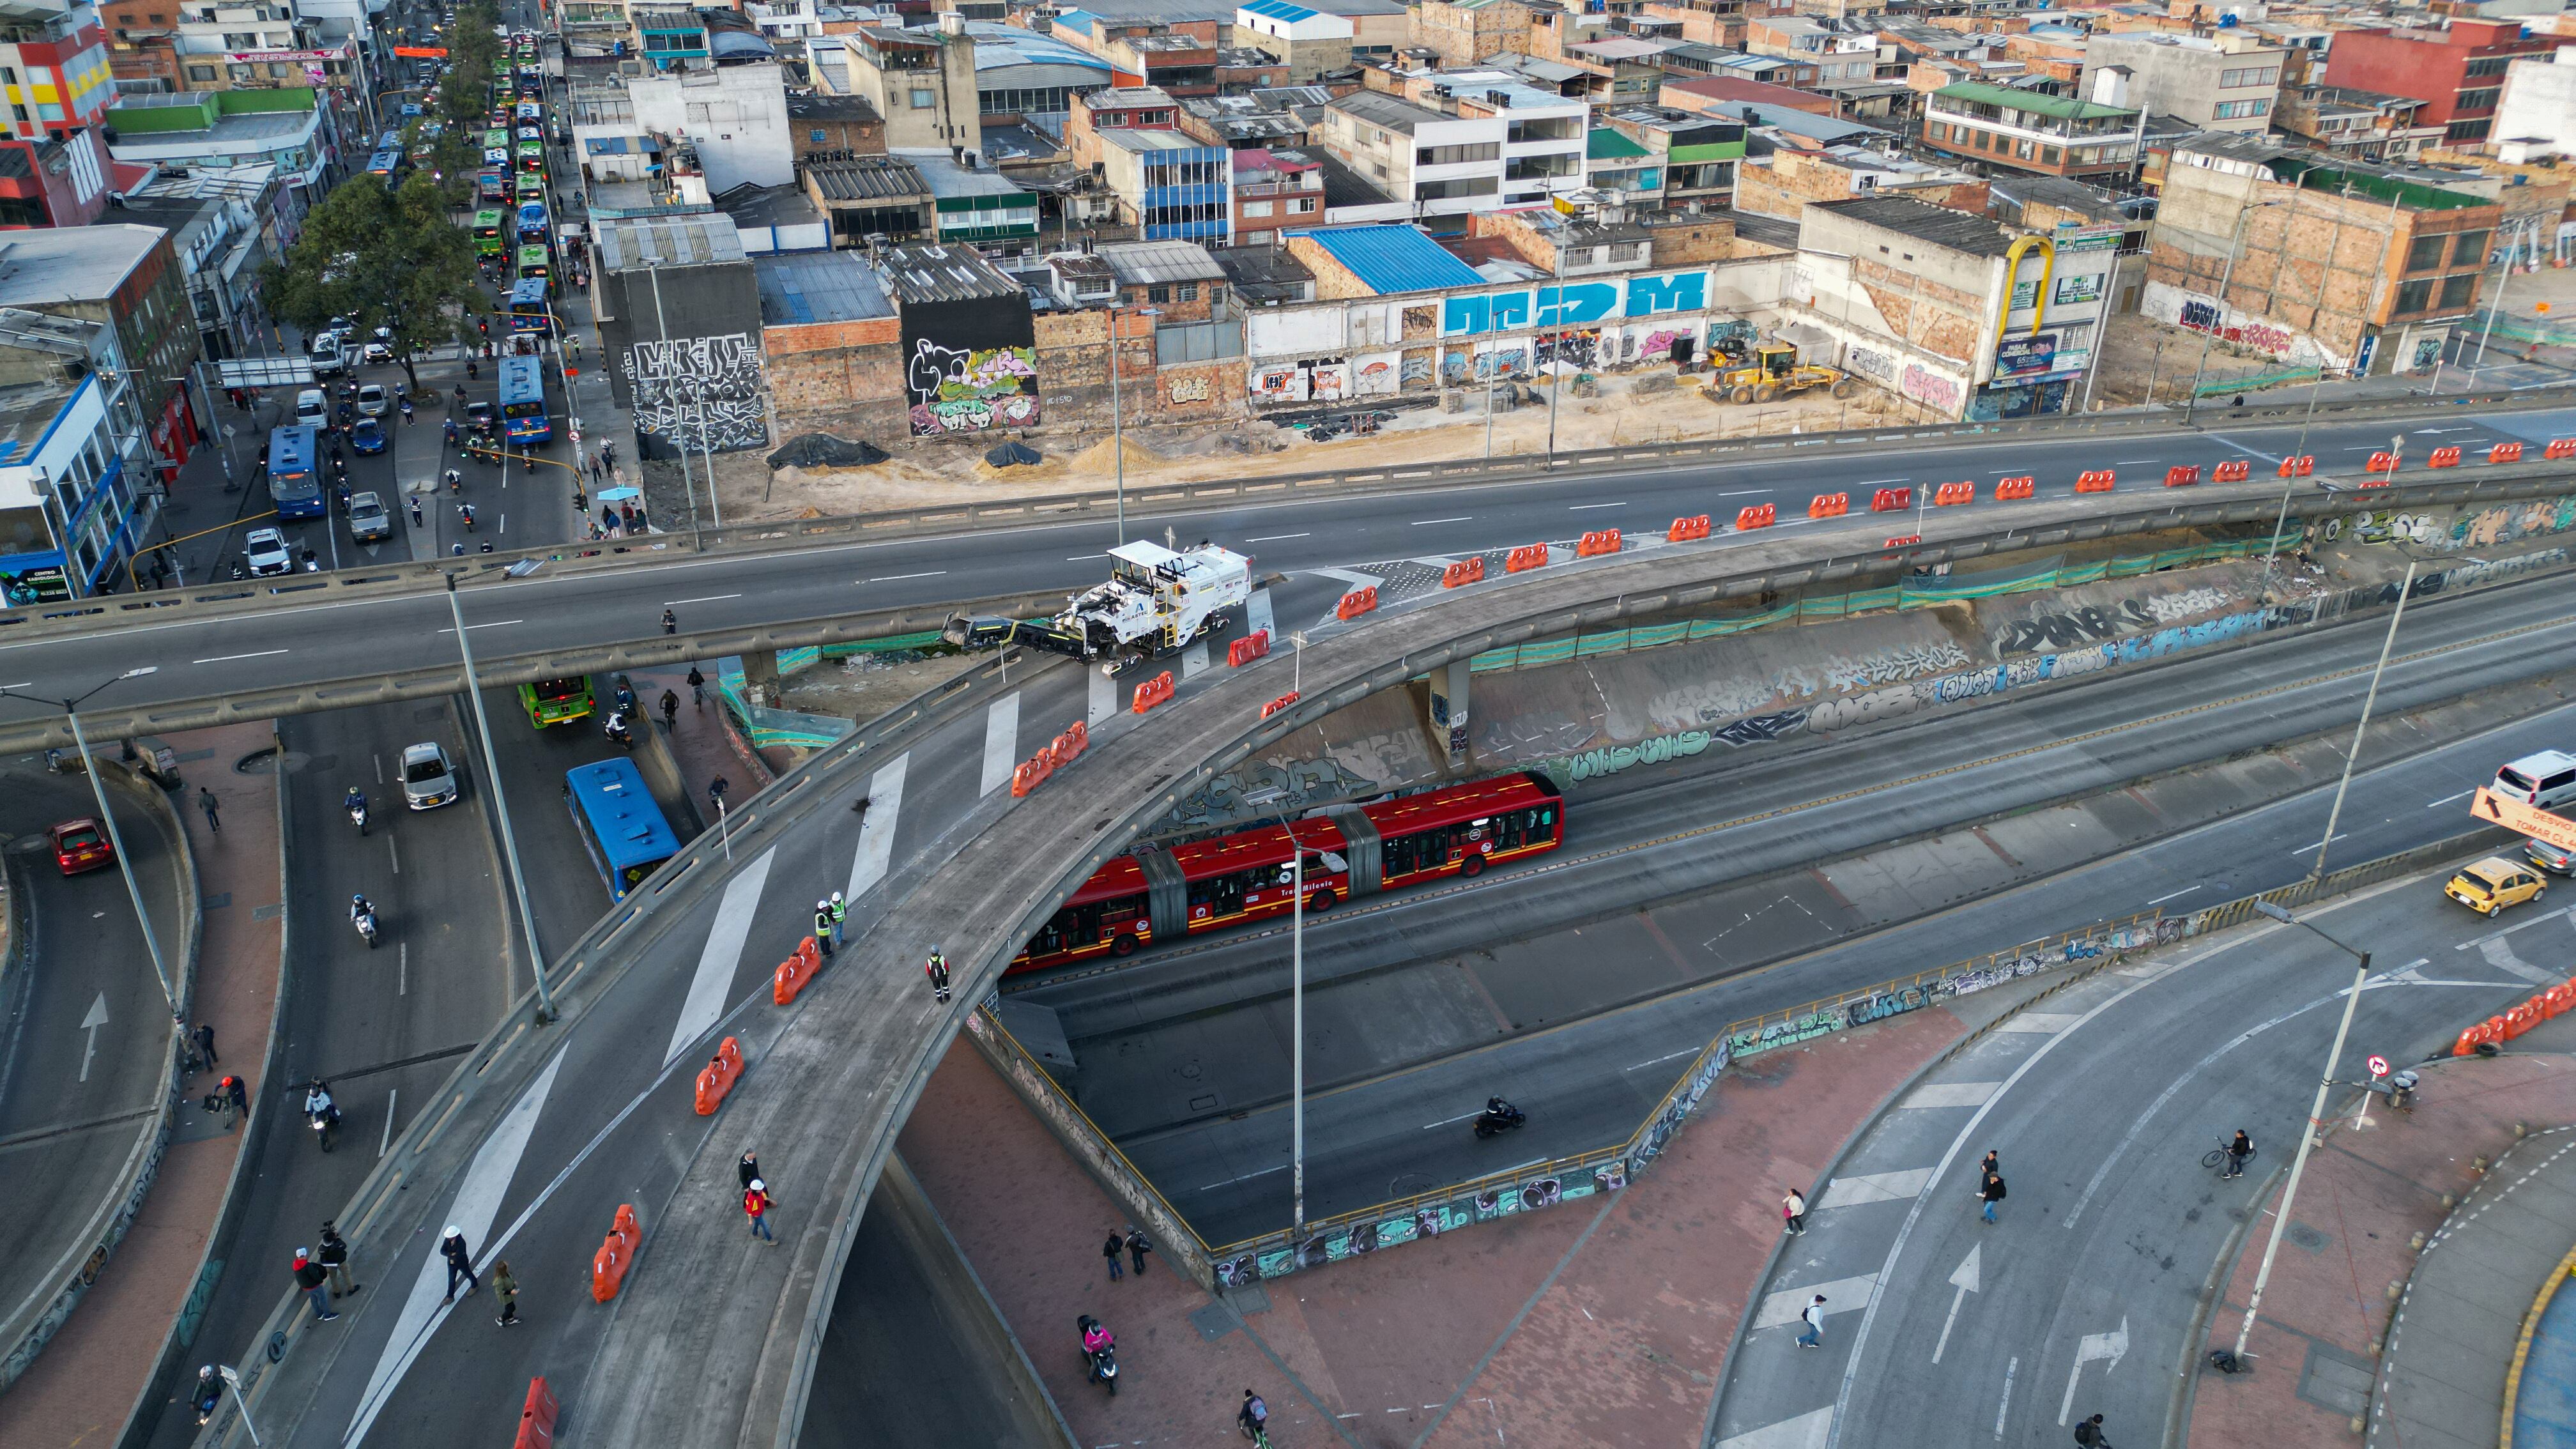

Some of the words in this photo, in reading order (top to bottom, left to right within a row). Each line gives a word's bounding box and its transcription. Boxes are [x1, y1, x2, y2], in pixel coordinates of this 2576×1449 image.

[2533, 811, 2572, 831] DESVIO
[2515, 820, 2550, 839] TOMAR
[2552, 833, 2564, 844] CL
[1281, 880, 1333, 896] TraMilenio
